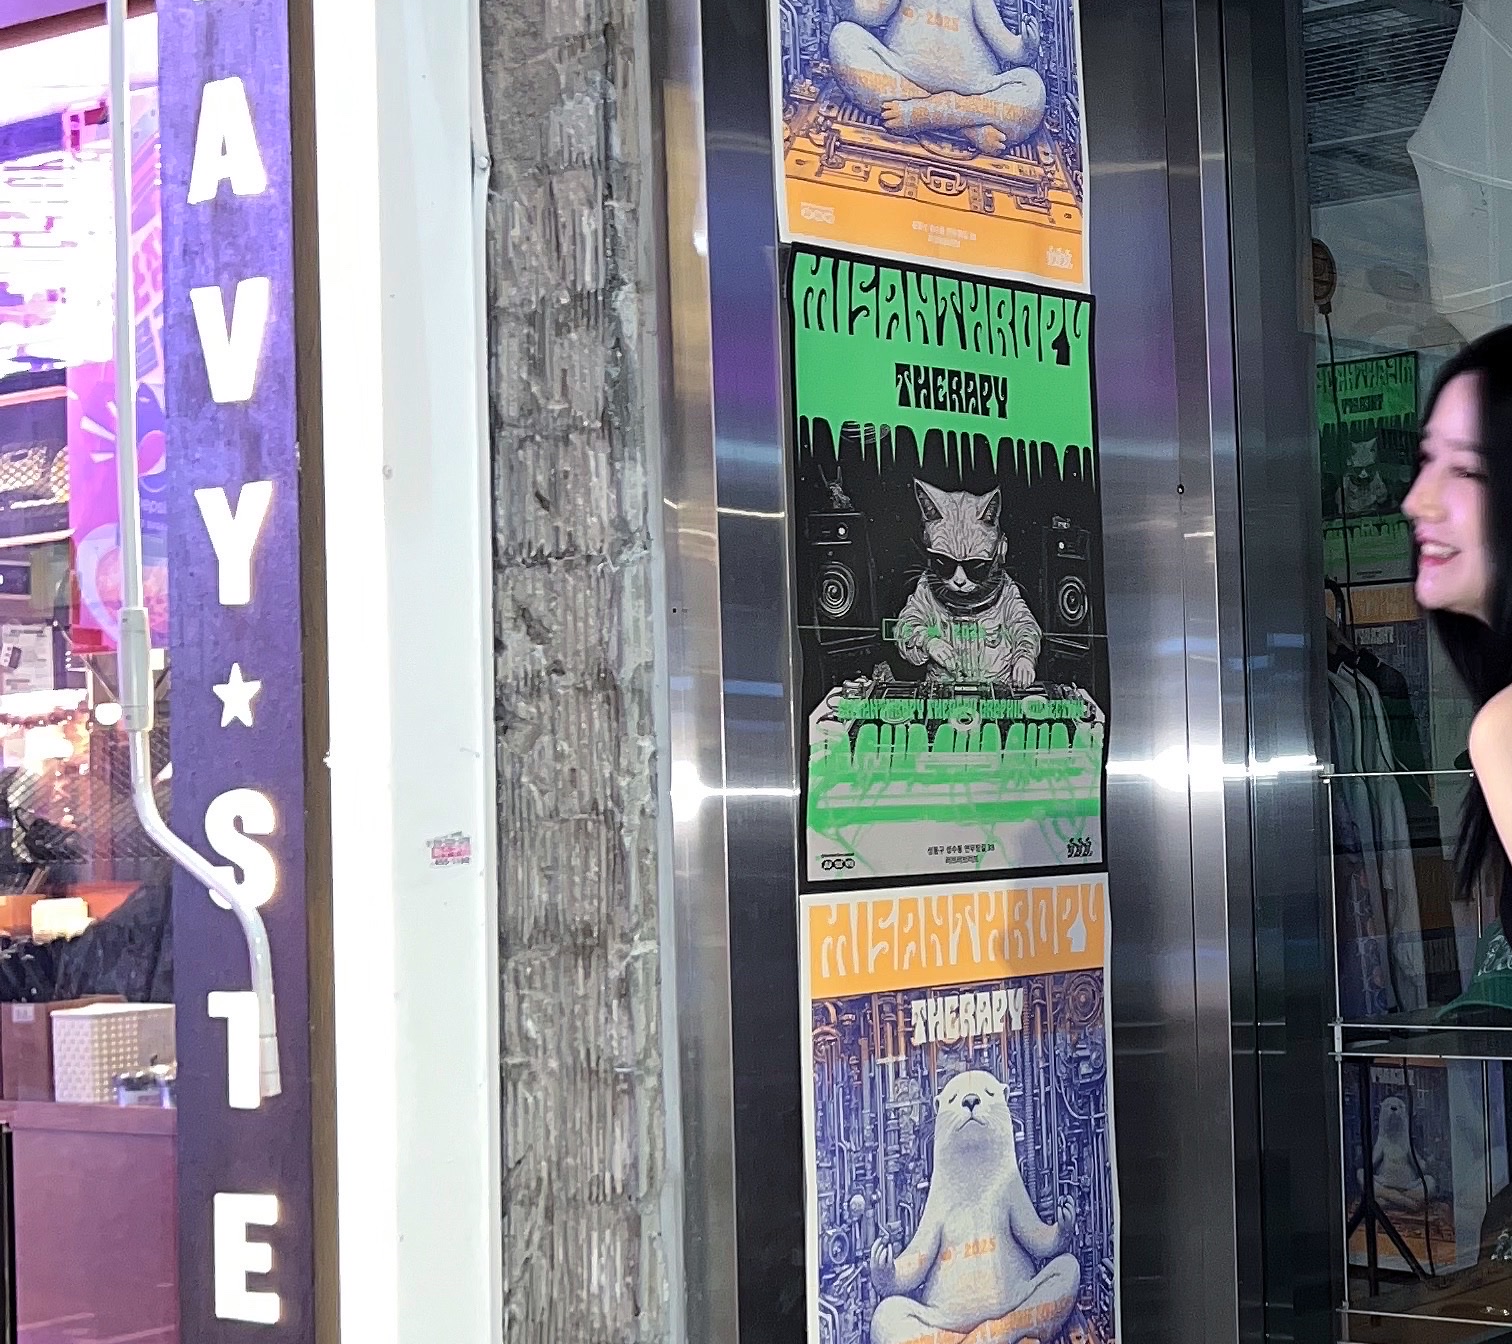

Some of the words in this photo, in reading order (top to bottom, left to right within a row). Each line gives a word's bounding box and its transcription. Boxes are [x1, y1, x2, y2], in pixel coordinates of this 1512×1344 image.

[794, 252, 1091, 367] MISANTHROPY
[895, 362, 1008, 420] THERAPY
[809, 883, 1105, 978] MISANTHROPY
[910, 987, 1024, 1046] THERAPY
